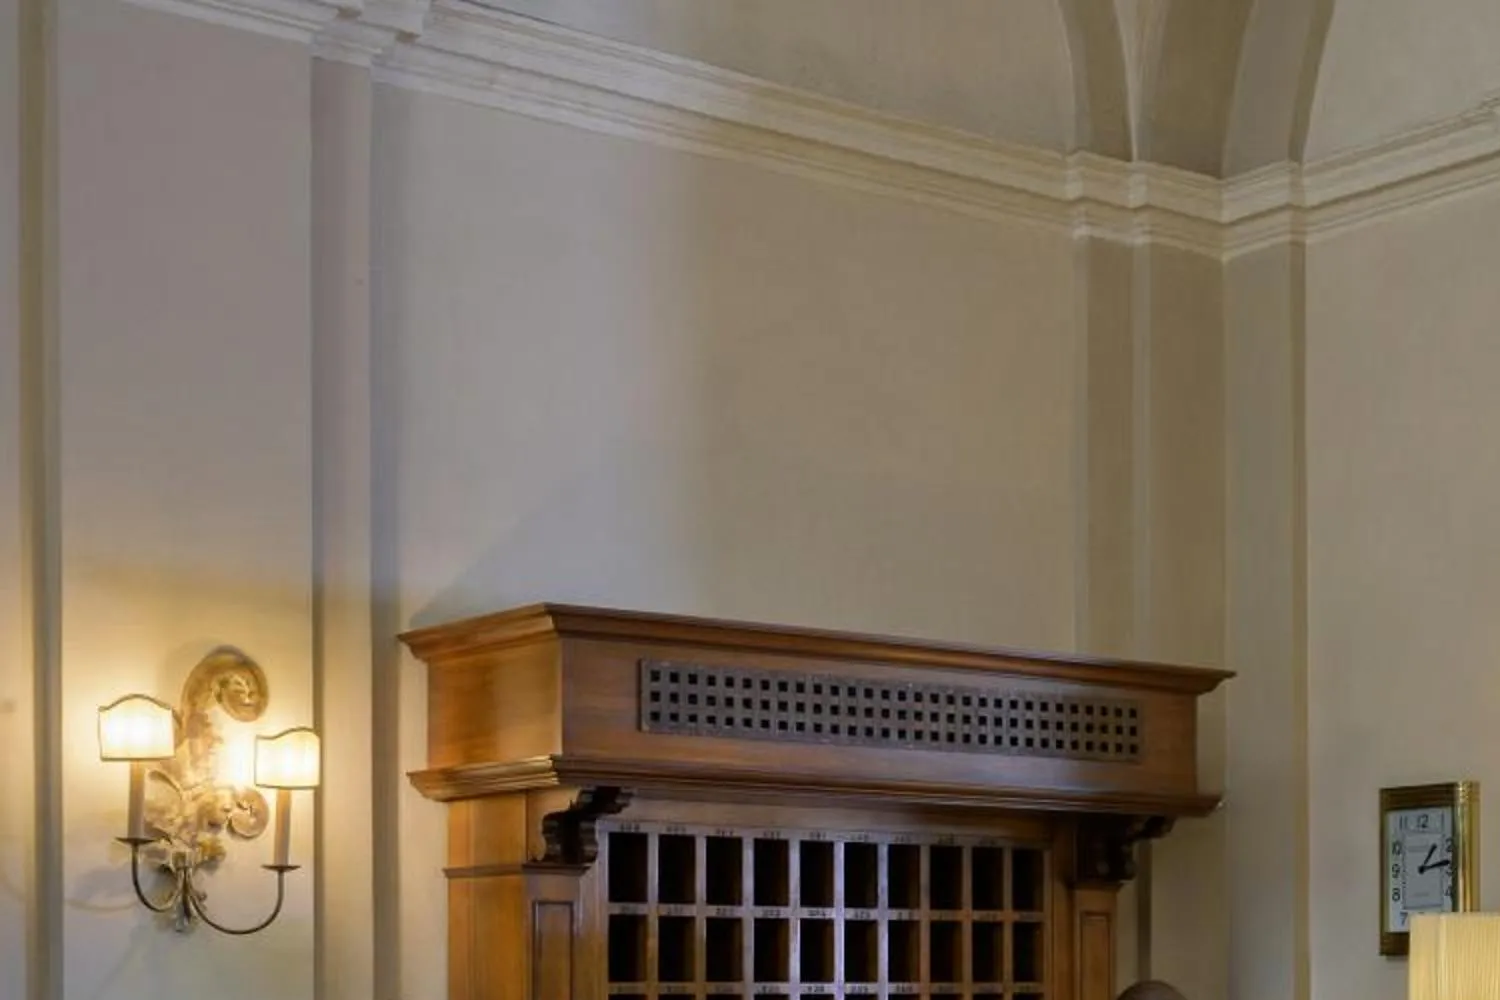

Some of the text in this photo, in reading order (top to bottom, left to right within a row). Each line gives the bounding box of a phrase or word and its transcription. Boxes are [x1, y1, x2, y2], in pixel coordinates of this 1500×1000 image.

[1416, 814, 1428, 828] 12
[1392, 863, 1400, 879] 9
[1391, 887, 1401, 902] 8
[1400, 911, 1408, 926] 7
